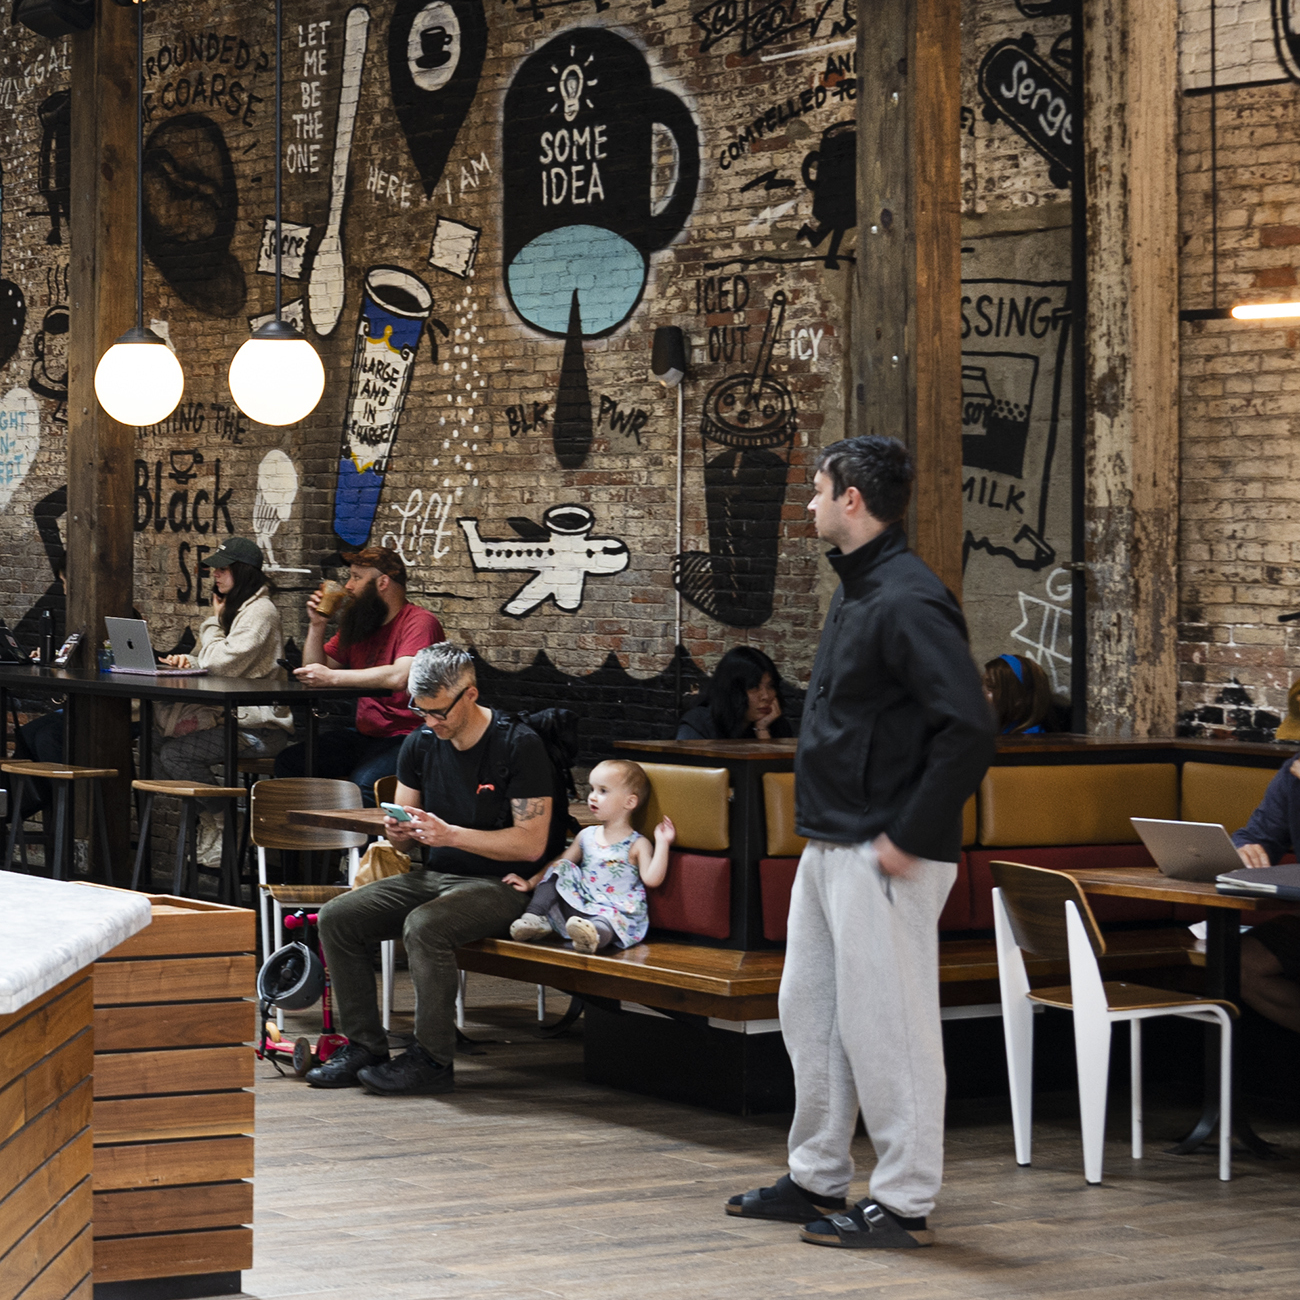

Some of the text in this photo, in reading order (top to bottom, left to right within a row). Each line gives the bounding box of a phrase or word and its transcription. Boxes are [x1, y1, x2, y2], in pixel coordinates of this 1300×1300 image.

[298, 20, 331, 47] LET
[711, 0, 738, 35] GO
[143, 32, 269, 84] ROUNDED?
[304, 49, 328, 77] ME
[825, 52, 857, 81] AN
[161, 72, 263, 127] COARSE
[300, 81, 321, 109] BE
[292, 111, 323, 139] THE
[720, 84, 827, 170] COMPELLED
[286, 143, 321, 174] ONE
[539, 125, 608, 164] SOME
[366, 152, 493, 208] HERE I AM
[541, 161, 605, 206] IDEA
[698, 274, 750, 316] ICED
[709, 325, 750, 364] OUT
[789, 327, 824, 362] ICY
[363, 357, 399, 388] LARGE
[361, 379, 389, 406] AND
[363, 402, 376, 423] IN
[505, 394, 649, 444] BLK PWR
[134, 458, 235, 534] Black
